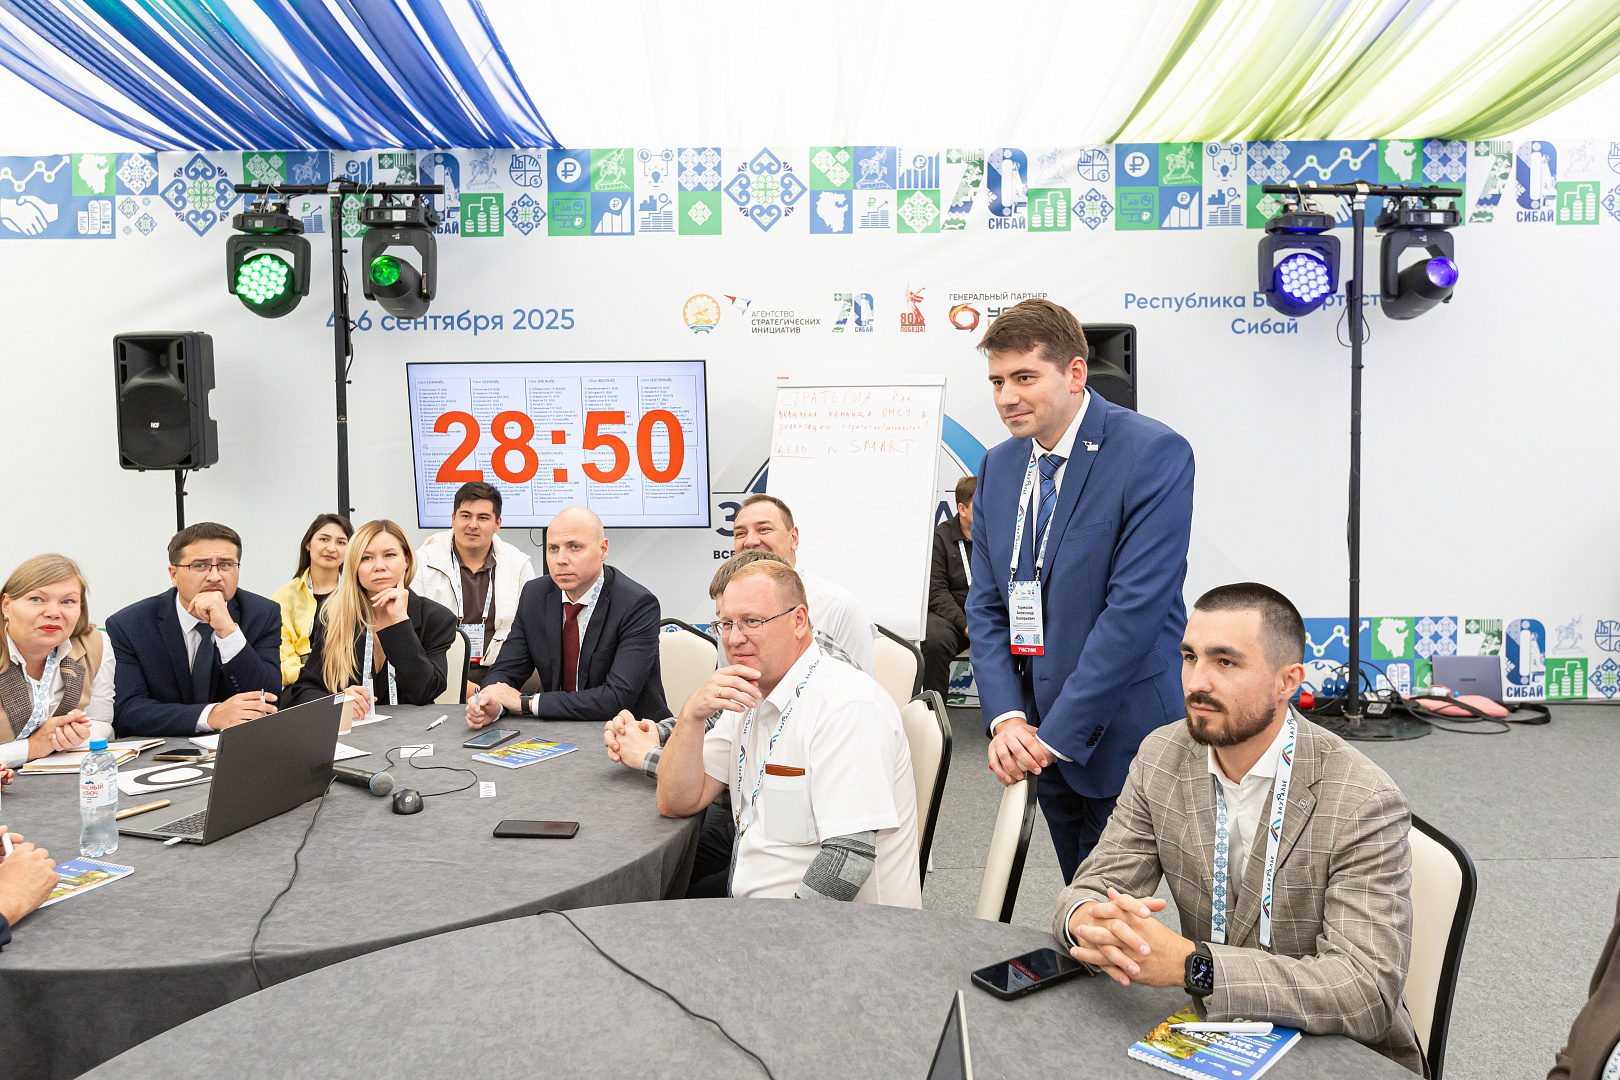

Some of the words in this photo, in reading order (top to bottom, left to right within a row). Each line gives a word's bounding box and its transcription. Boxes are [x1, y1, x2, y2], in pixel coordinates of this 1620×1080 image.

[988, 216, 1026, 230] СИБАЙ
[1516, 210, 1554, 223] СИБАЙ
[949, 292, 1008, 301] ГЕНЕРАЛЬНЫЙ
[1011, 292, 1048, 300] ПАРТНЕР
[1124, 292, 1246, 312] Республика
[380, 309, 504, 336] сентября
[512, 308, 575, 331] 2025
[900, 312, 914, 325] 80
[1231, 318, 1298, 334] Сибай
[781, 390, 871, 407] СТРАТЕГИЯ
[434, 410, 685, 483] 28:50
[850, 438, 917, 456] SMART
[1506, 685, 1543, 698] СИБАЙ
[1277, 779, 1288, 816] ЗАУРАЛЬЕ
[1266, 855, 1275, 891] ЗАУРАЛЬЕ
